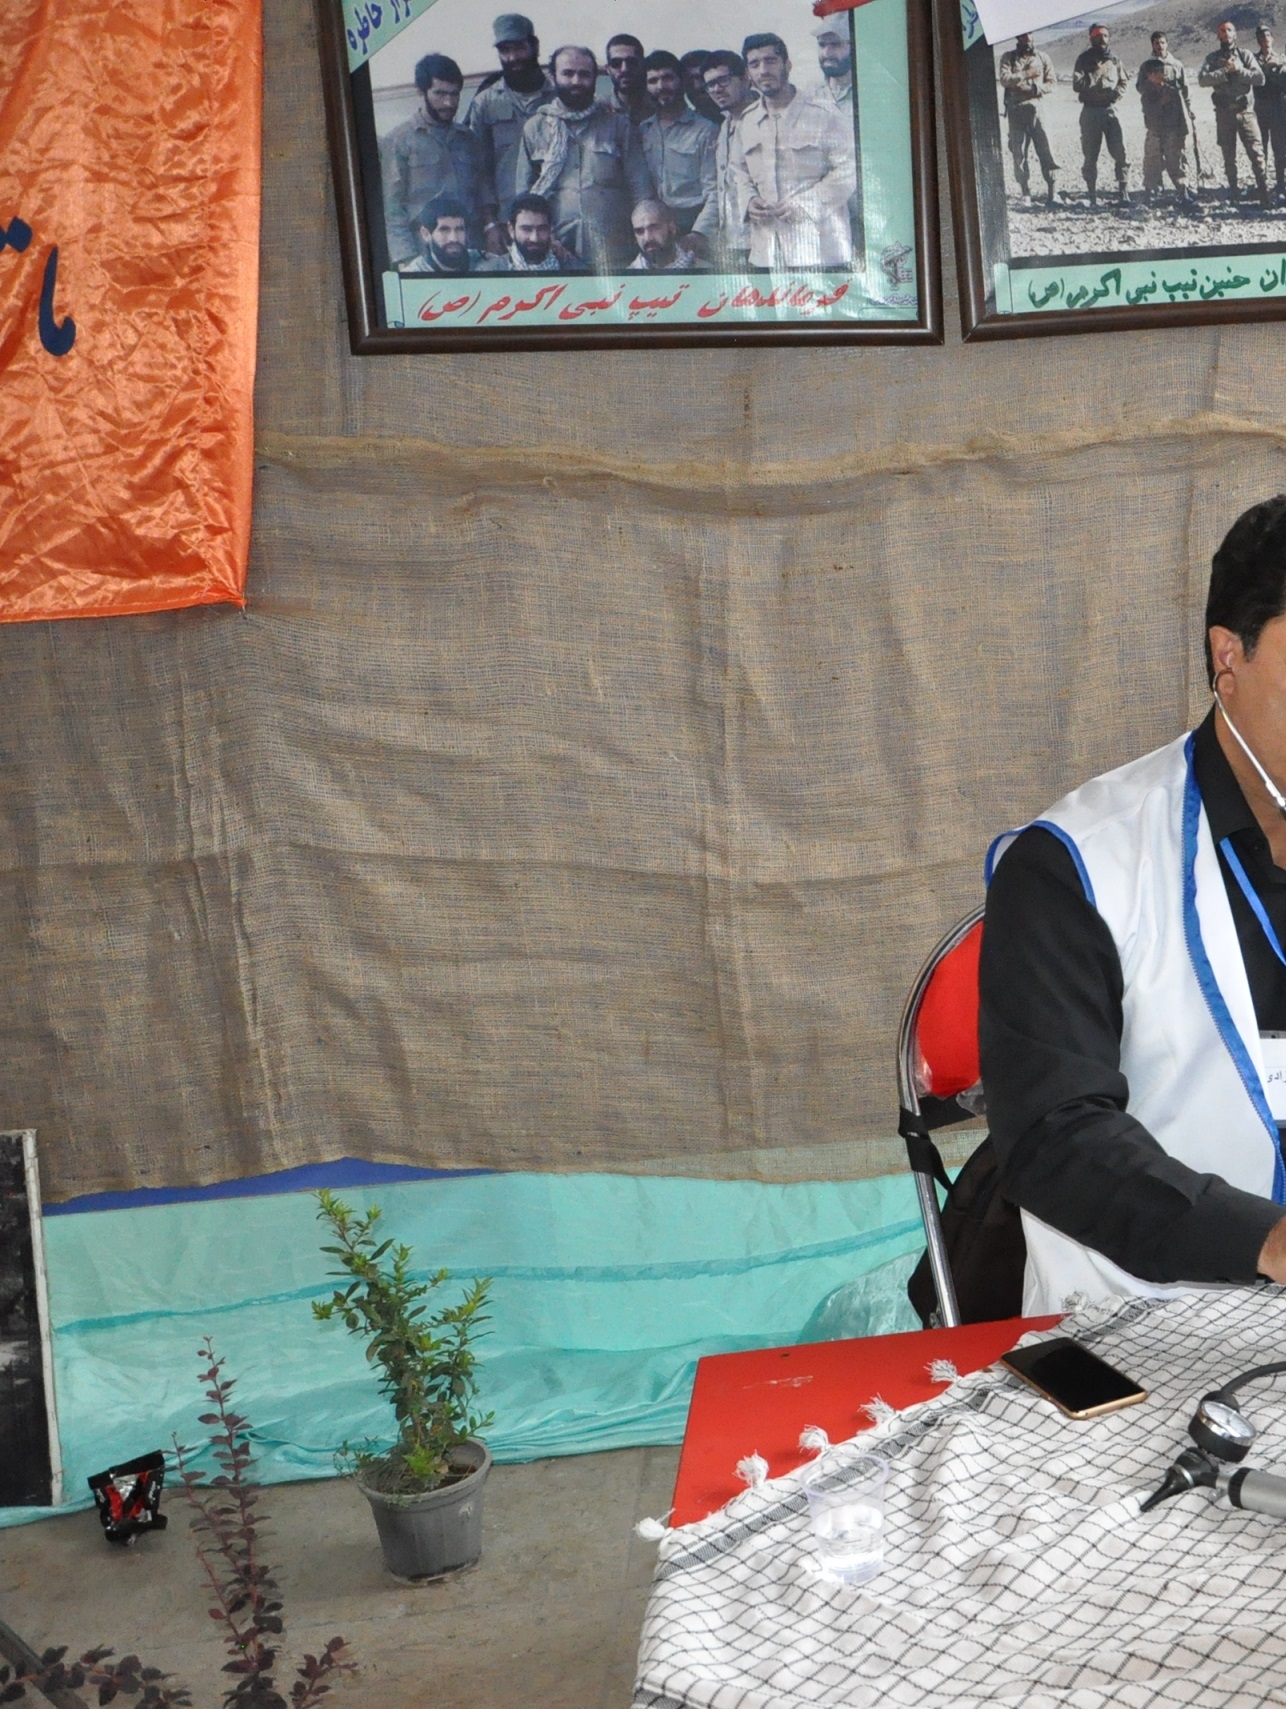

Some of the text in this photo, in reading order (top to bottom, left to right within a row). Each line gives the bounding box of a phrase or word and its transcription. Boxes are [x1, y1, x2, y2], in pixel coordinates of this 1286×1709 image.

[476, 283, 569, 325] اکرم
[1126, 270, 1157, 305] نبی
[417, 290, 482, 321] (ص)
